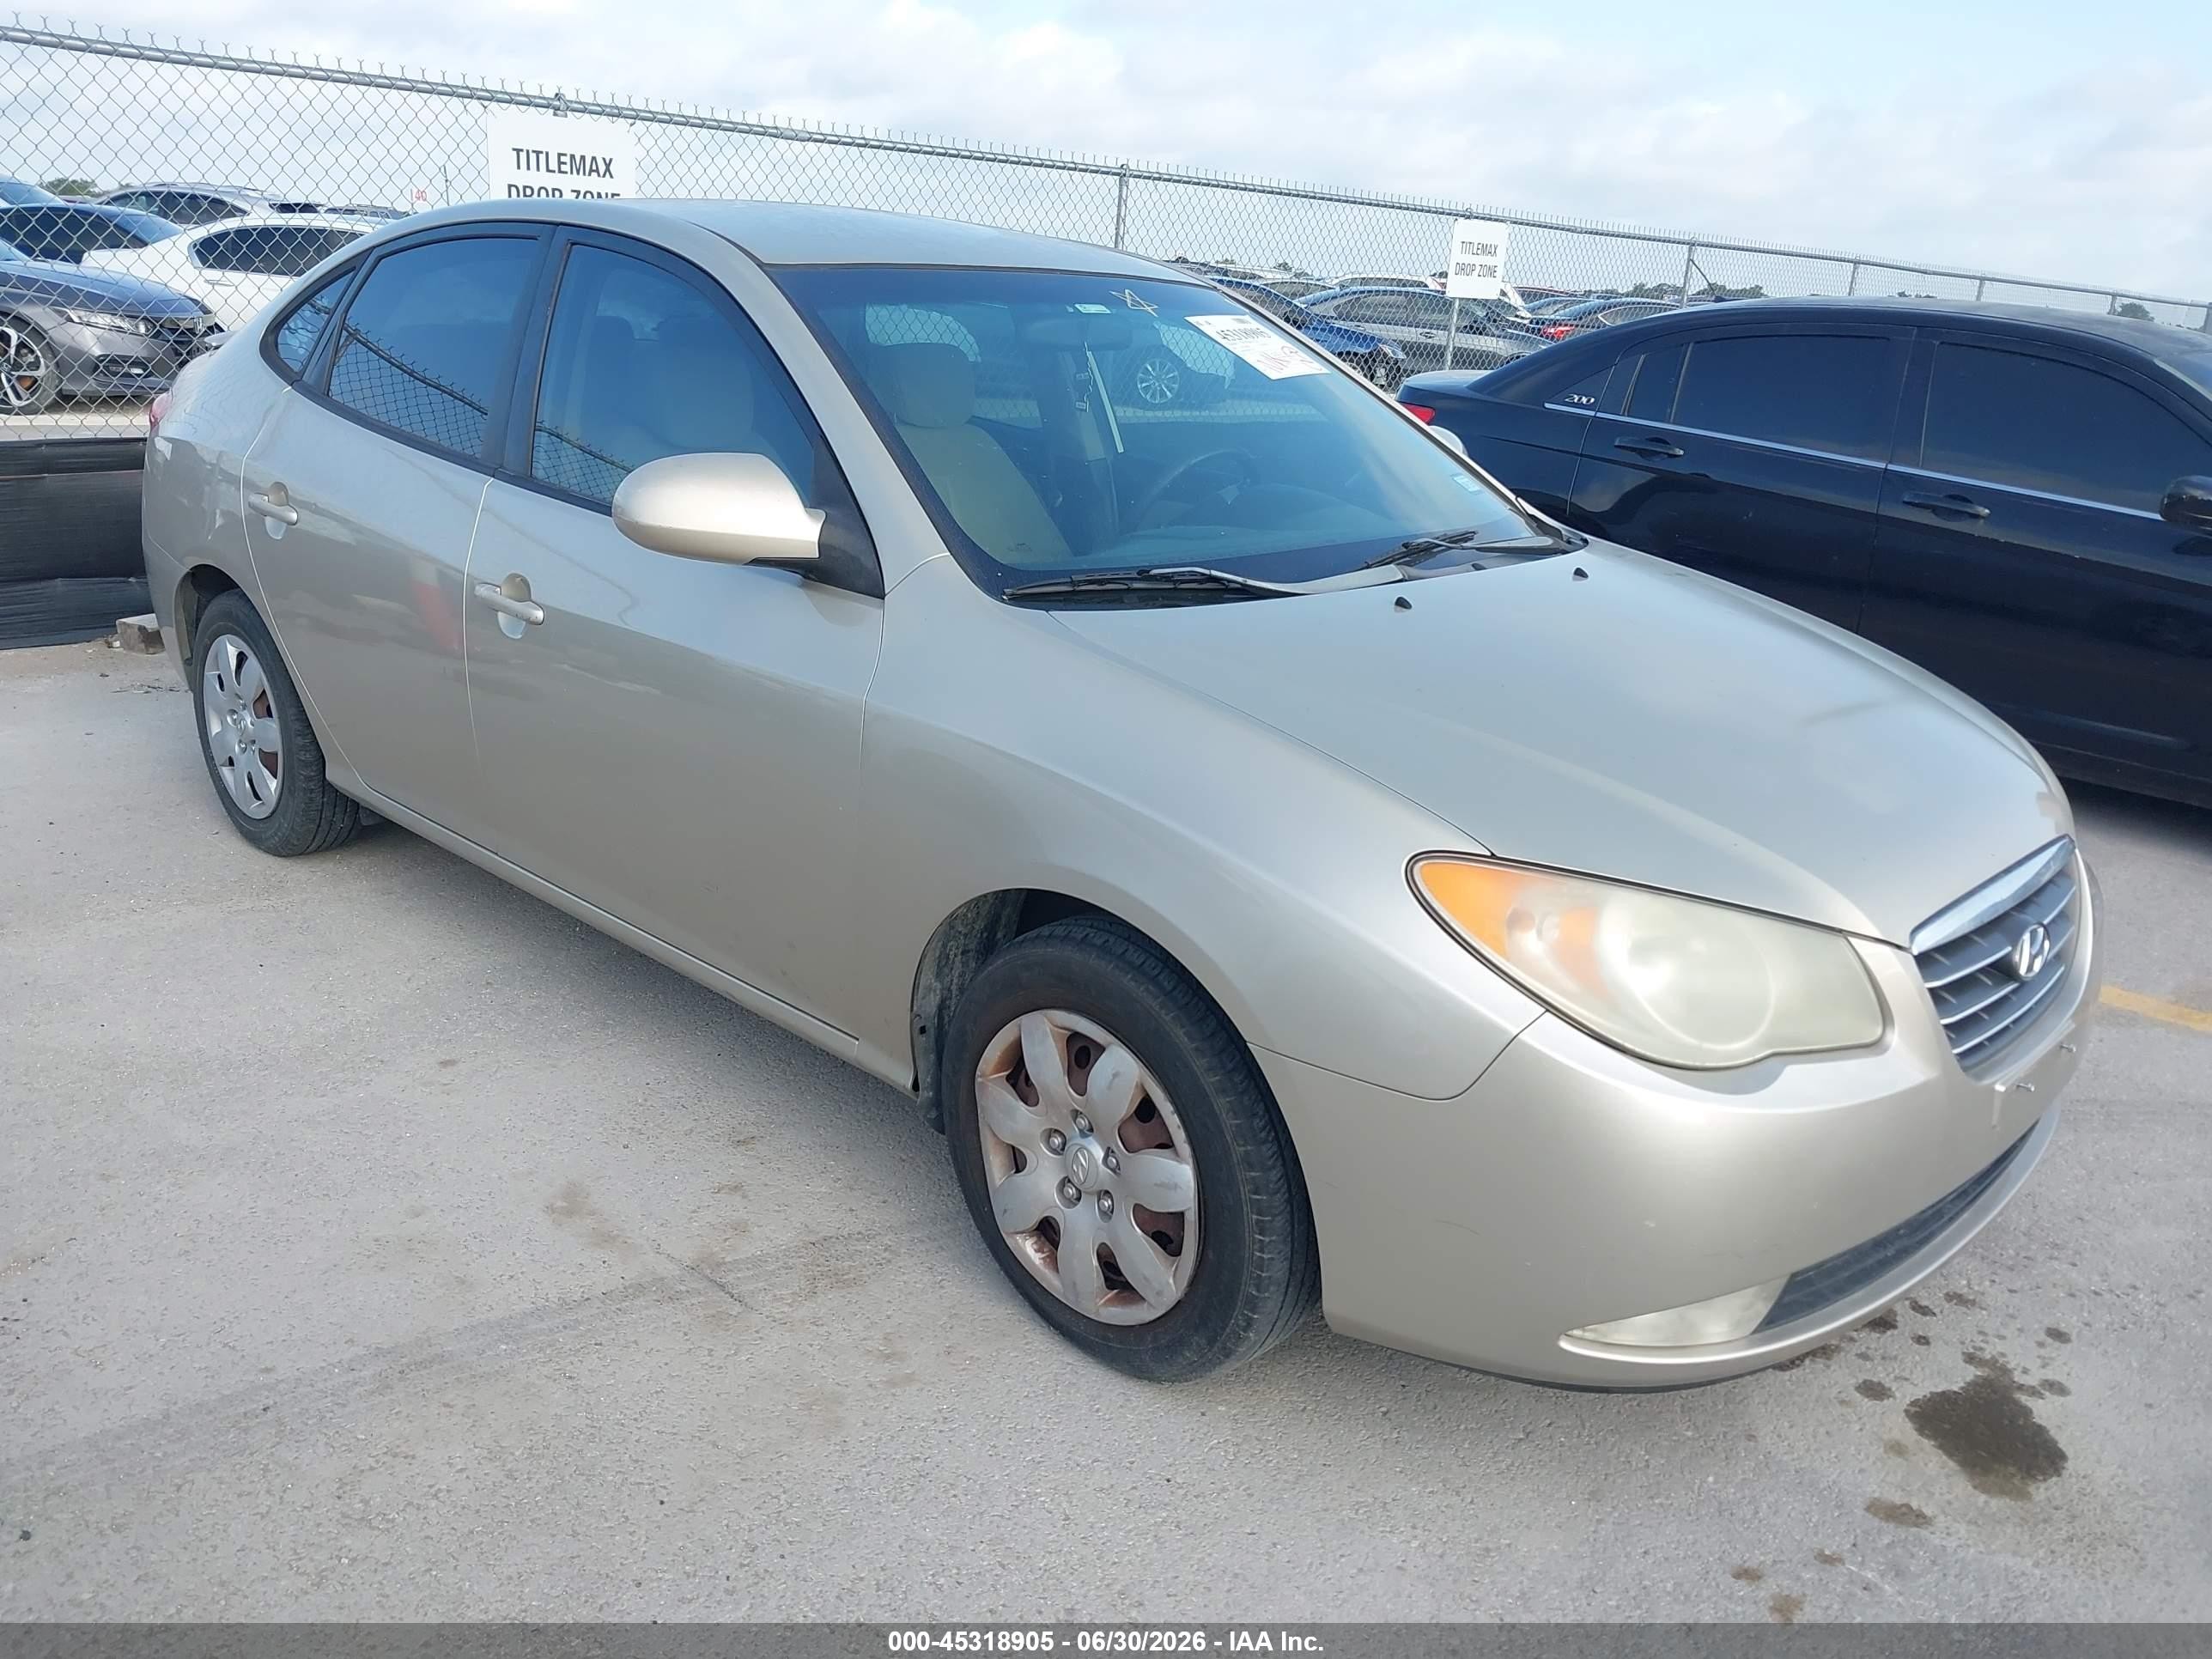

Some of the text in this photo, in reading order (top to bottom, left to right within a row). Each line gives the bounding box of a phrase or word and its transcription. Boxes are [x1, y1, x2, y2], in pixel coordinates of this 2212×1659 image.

[512, 148, 614, 179] TITLEMAX
[1461, 241, 1498, 257] TITLEMAX
[1455, 262, 1498, 278] DROP ZONE
[1565, 393, 1595, 404] 200
